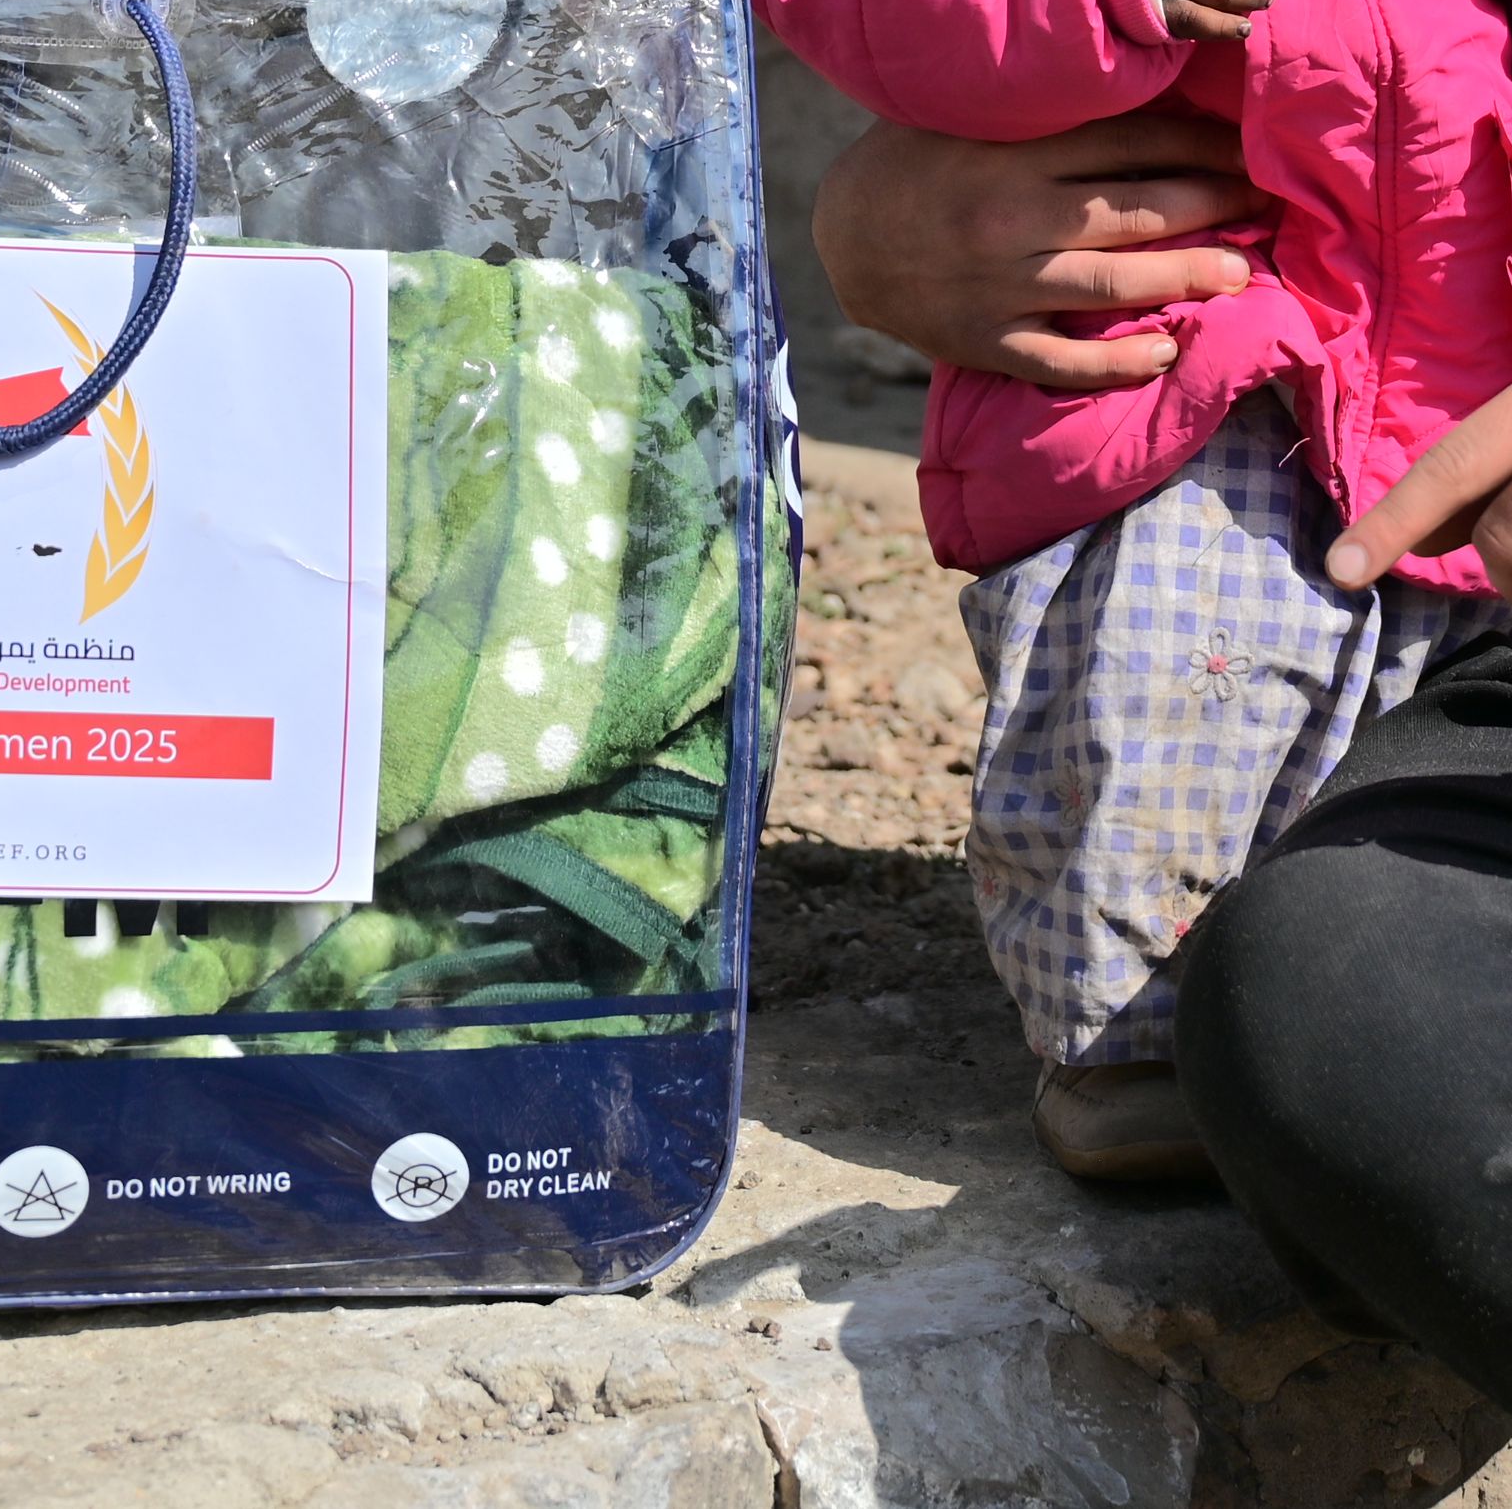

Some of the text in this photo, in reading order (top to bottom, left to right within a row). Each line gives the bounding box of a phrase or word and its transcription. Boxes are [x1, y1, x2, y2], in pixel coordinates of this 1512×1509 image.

[43, 637, 135, 662] منظمة
[87, 728, 178, 764] 2025
[487, 1147, 572, 1174] DO NOT
[106, 1171, 292, 1200] DO NOT WRING
[486, 1170, 611, 1199] DRY CLEAN
